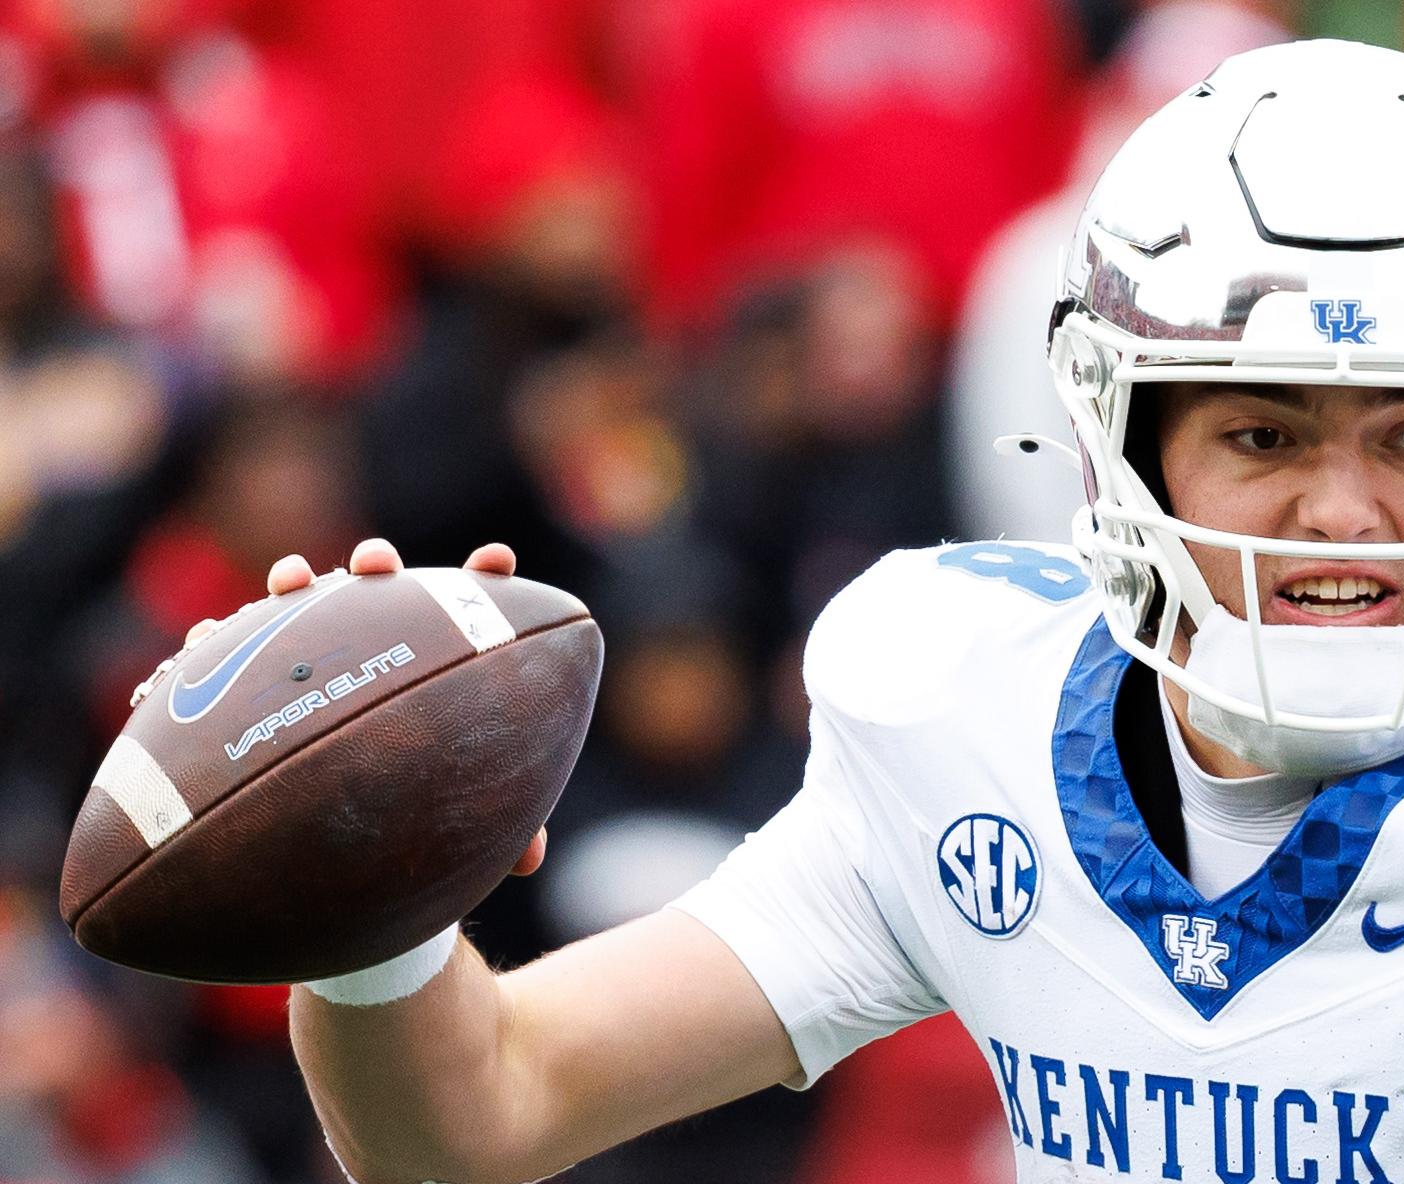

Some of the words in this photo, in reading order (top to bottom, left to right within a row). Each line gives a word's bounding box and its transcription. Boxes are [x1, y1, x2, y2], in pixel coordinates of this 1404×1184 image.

[1310, 299, 1377, 344] UK
[936, 542, 1095, 606] 8
[224, 690, 329, 760] VAPOR
[325, 643, 415, 700] ELITE
[941, 815, 1037, 936] SEC
[1160, 914, 1230, 990] UK
